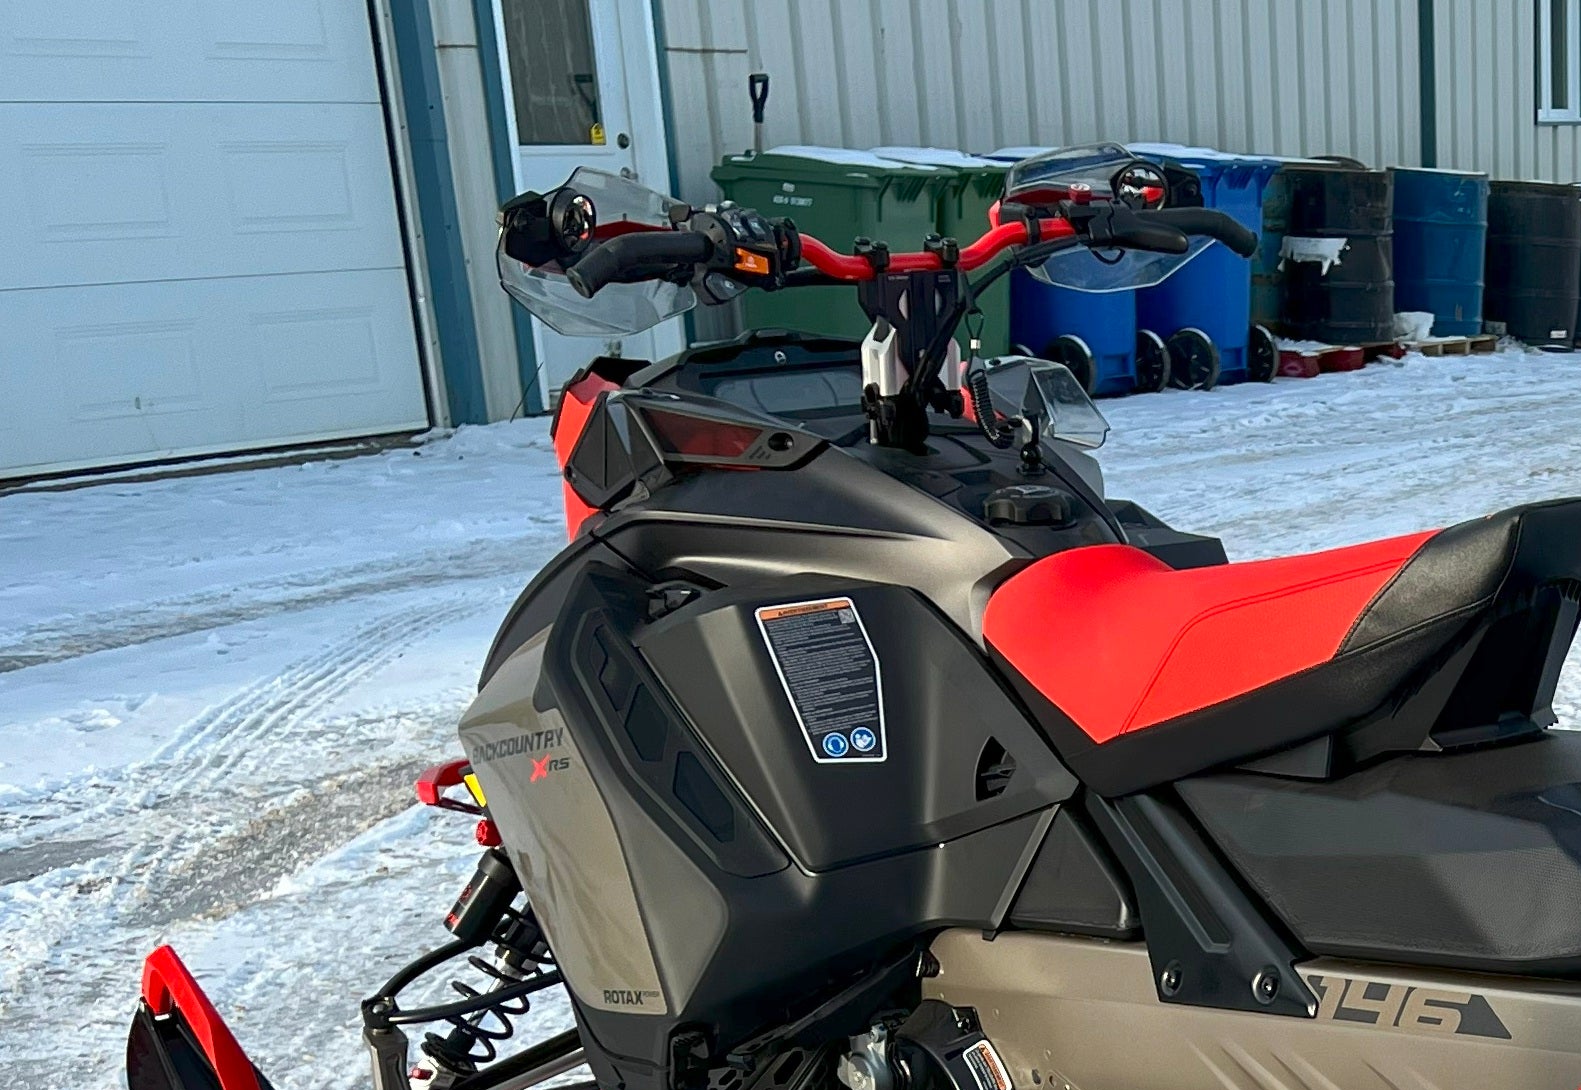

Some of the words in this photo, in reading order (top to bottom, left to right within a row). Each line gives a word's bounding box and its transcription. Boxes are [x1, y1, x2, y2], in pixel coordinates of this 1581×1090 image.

[473, 727, 563, 765] BACKCOUNTRY
[604, 989, 643, 1005] ROTAX
[1317, 976, 1472, 1034] 146
